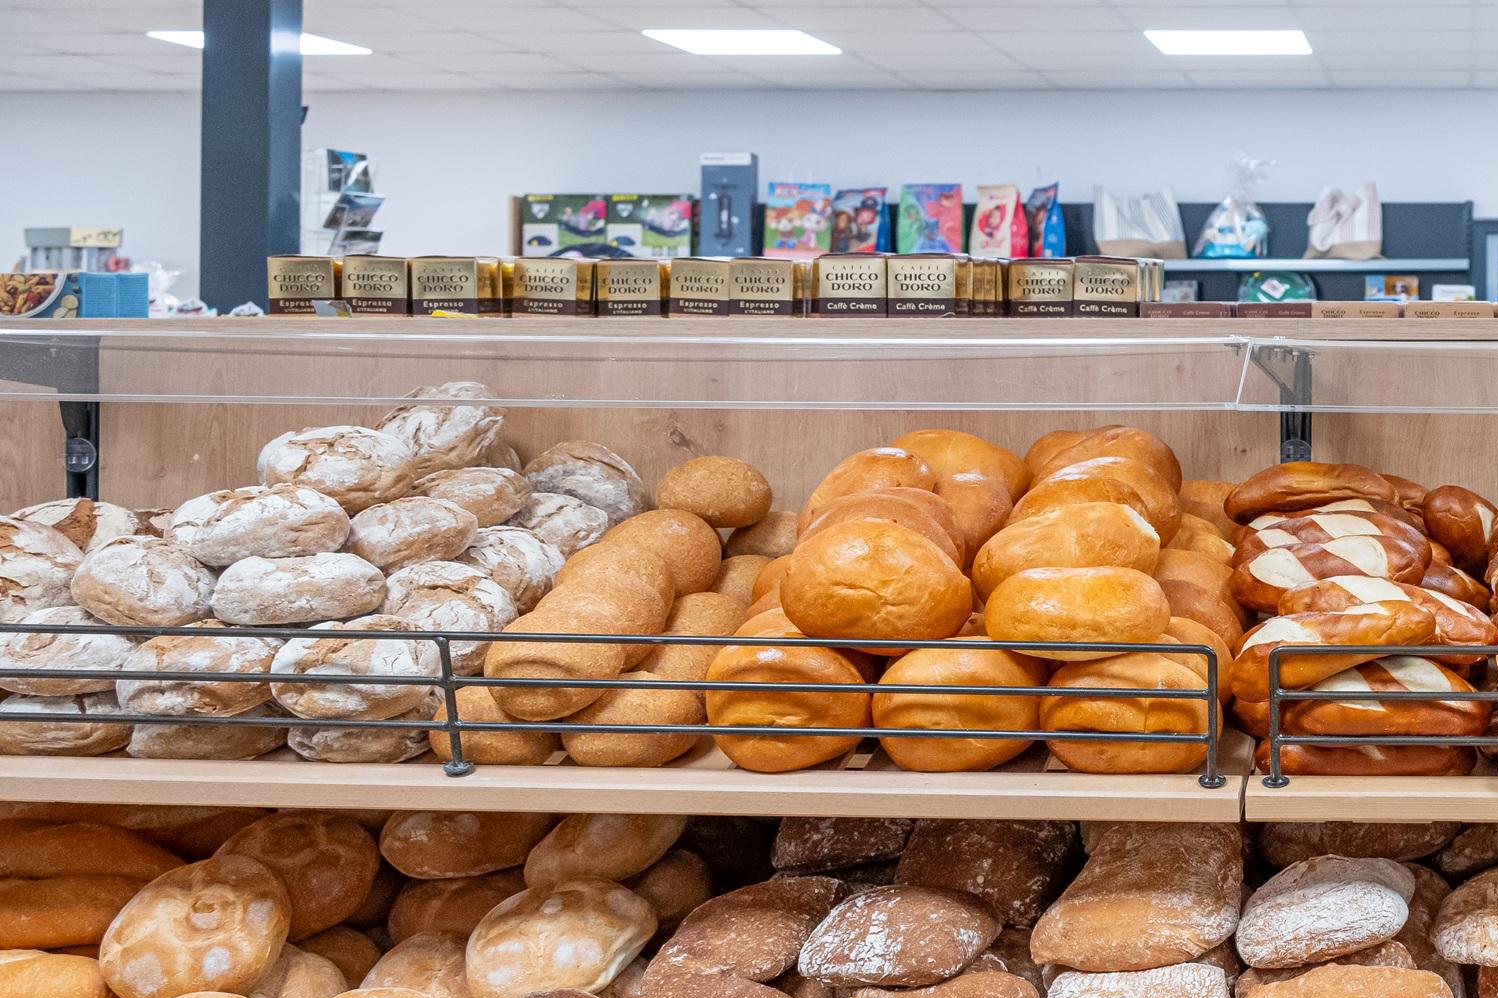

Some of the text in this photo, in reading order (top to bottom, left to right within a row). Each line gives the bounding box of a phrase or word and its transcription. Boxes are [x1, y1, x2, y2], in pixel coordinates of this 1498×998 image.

[273, 273, 325, 282] CHICCO
[347, 273, 399, 283] CHICCO
[417, 275, 469, 283] CHICCO
[520, 275, 570, 284] CHICCO
[602, 277, 652, 285] CHICCO
[675, 276, 724, 284] CHICCO
[735, 276, 785, 284] CHICCO
[825, 272, 878, 281] CHICCO
[895, 273, 947, 282] CHICCO
[1017, 278, 1066, 287] CHICCO
[352, 299, 392, 308] Espresso
[423, 301, 463, 309] Espresso
[523, 300, 563, 309] Espresso
[608, 302, 647, 310] Espresso
[679, 300, 718, 308] Espresso
[740, 301, 780, 309] Espresso
[827, 302, 877, 310] Caffè Crème
[896, 302, 946, 311] Caffè Crème
[1101, 304, 1128, 313] Crème
